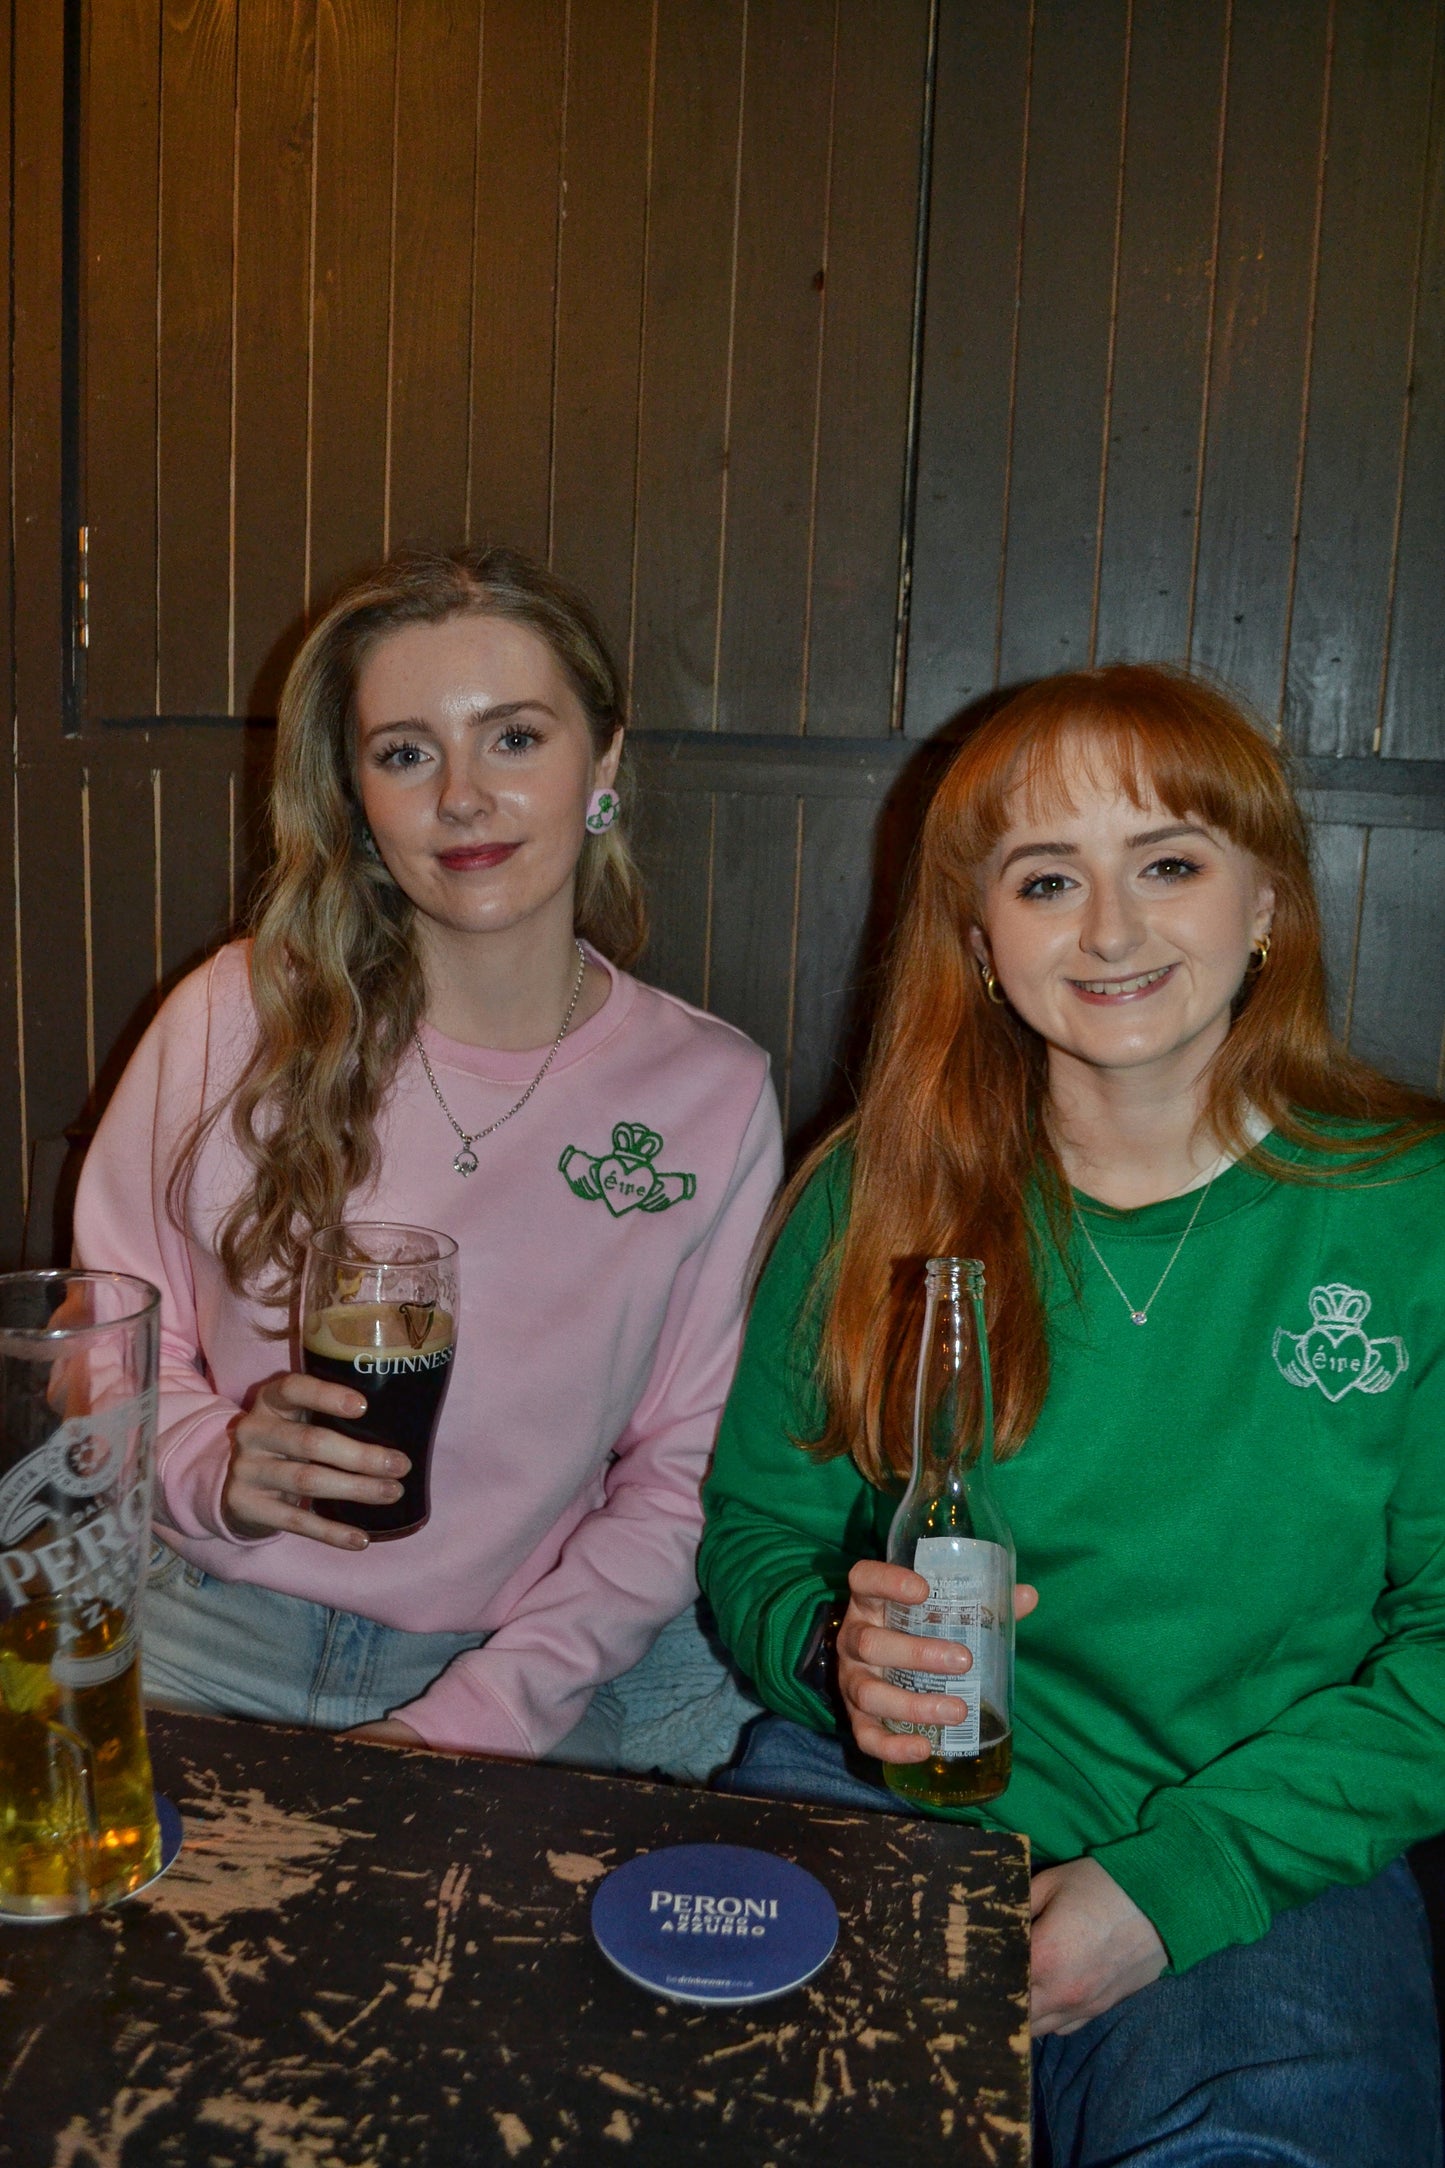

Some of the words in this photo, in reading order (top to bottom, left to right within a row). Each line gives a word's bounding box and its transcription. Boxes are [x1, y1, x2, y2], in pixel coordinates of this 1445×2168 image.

[650, 1890, 779, 1919] PERONI
[678, 1913, 748, 1925] NASTRO
[660, 1920, 766, 1937] AZZURRO
